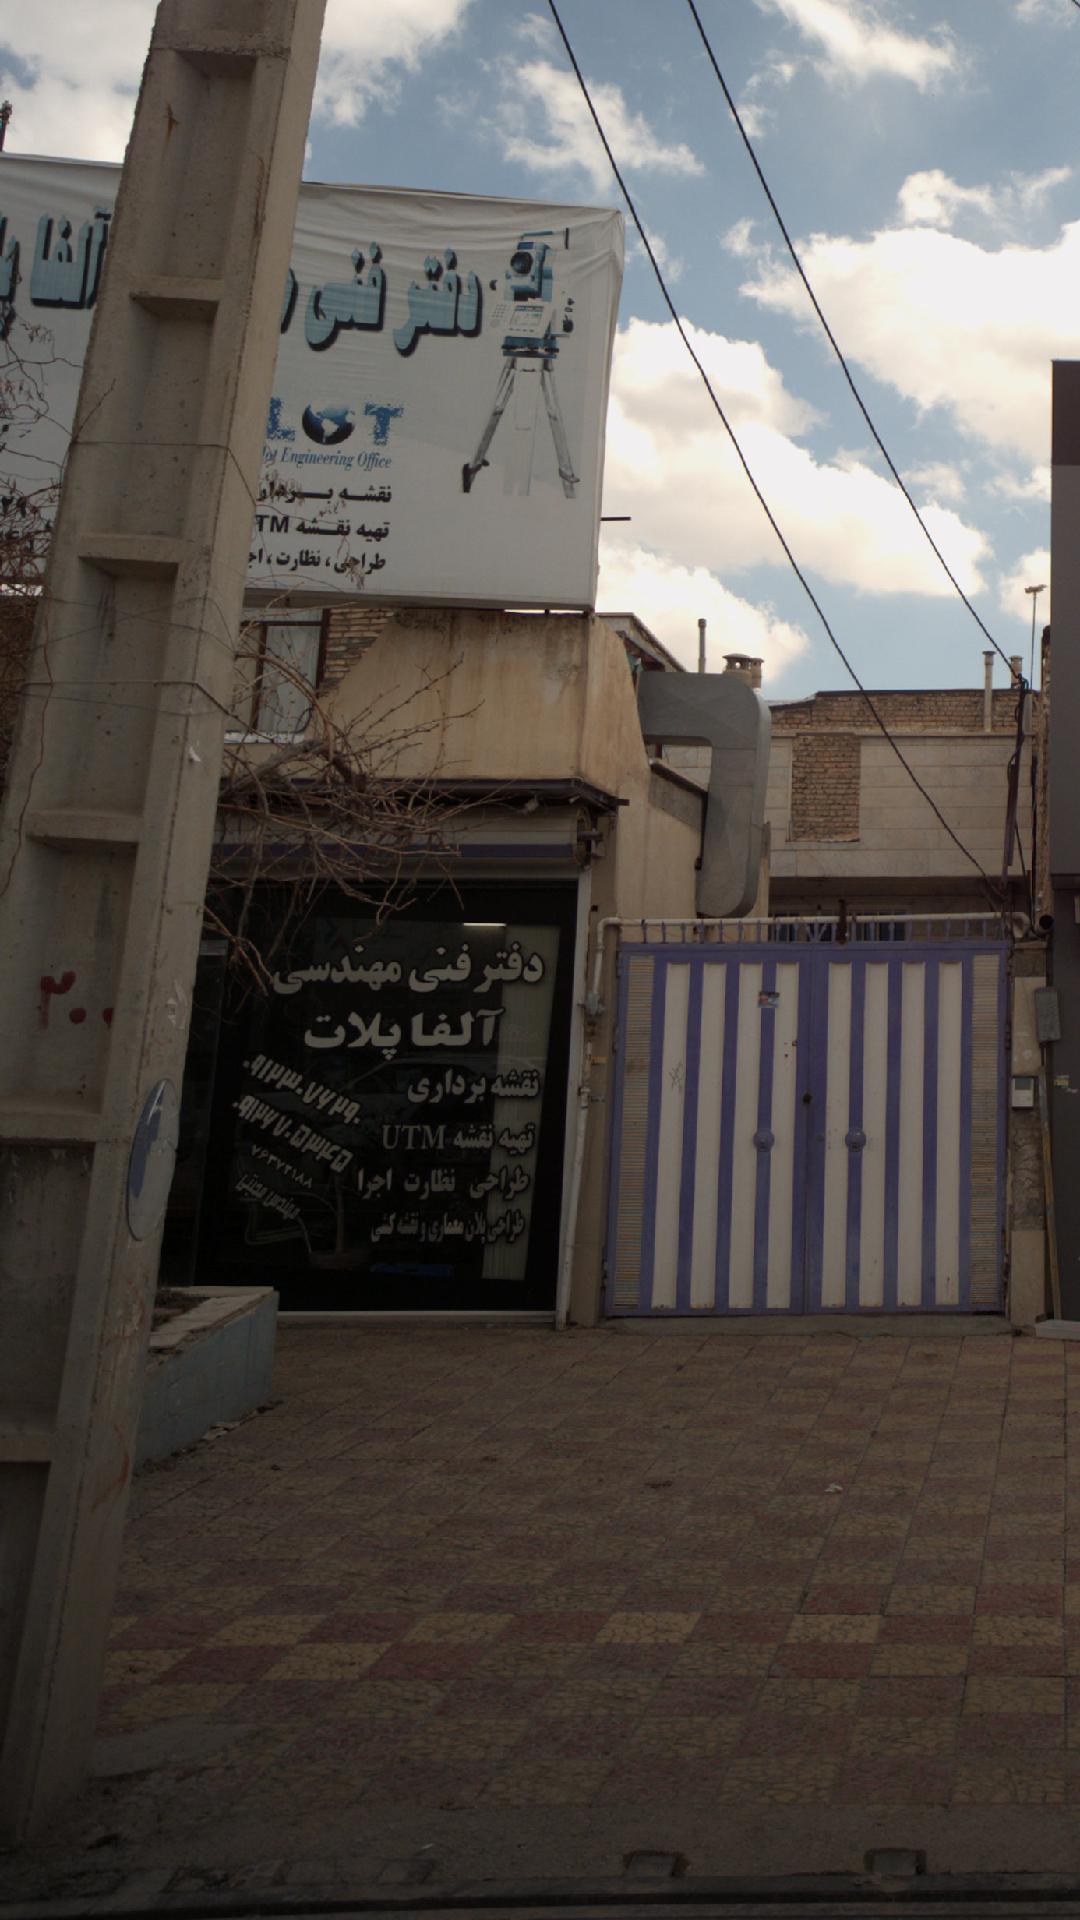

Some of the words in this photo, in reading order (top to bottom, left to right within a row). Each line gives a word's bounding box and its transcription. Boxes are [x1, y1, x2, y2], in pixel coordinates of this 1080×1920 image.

[30, 206, 112, 309] آلفا
[304, 240, 387, 351] فنی
[393, 248, 482, 358] دفتر
[280, 446, 354, 472] Engineering
[357, 451, 392, 473] Office
[257, 480, 333, 504] بردار
[339, 485, 391, 502] نقشه
[257, 514, 289, 533] TM
[296, 517, 351, 537] نقشه
[356, 521, 390, 543] تهیه
[272, 944, 402, 995] مهندسی
[408, 943, 472, 993] فنی
[473, 941, 544, 993] دفتر
[304, 1010, 402, 1061] پلات
[411, 1007, 505, 1047] آلفا
[407, 1068, 487, 1104] برداری
[490, 1069, 539, 1097] نقشه
[382, 1124, 447, 1150] UTM
[453, 1123, 495, 1150] نقشه
[499, 1122, 535, 1155] تهیه
[357, 1166, 394, 1200] اجرا
[403, 1168, 456, 1200] نظارت
[469, 1165, 530, 1200] طراحی
[486, 1209, 525, 1243] طراحی
